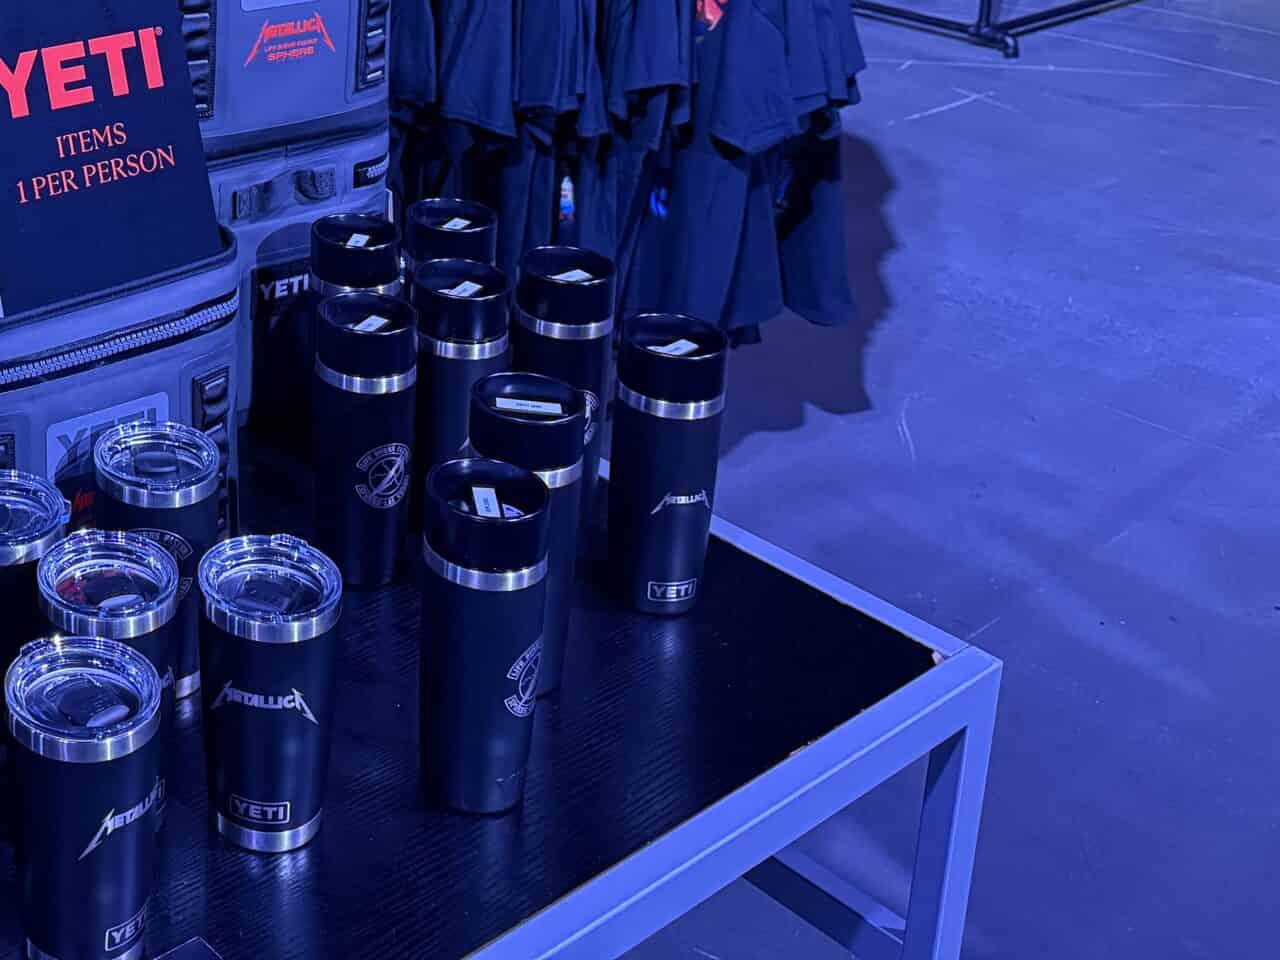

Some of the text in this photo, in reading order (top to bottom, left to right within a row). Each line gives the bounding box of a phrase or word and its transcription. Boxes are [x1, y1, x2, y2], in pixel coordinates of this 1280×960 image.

[244, 11, 335, 67] METALLICA
[55, 122, 128, 158] ITEMS
[16, 145, 177, 204] 1 PER PERSON
[257, 273, 309, 300] YETI
[650, 490, 711, 514] METALLICA
[653, 582, 694, 597] YETI
[210, 680, 320, 725] METALLICA
[235, 798, 284, 820] YETI
